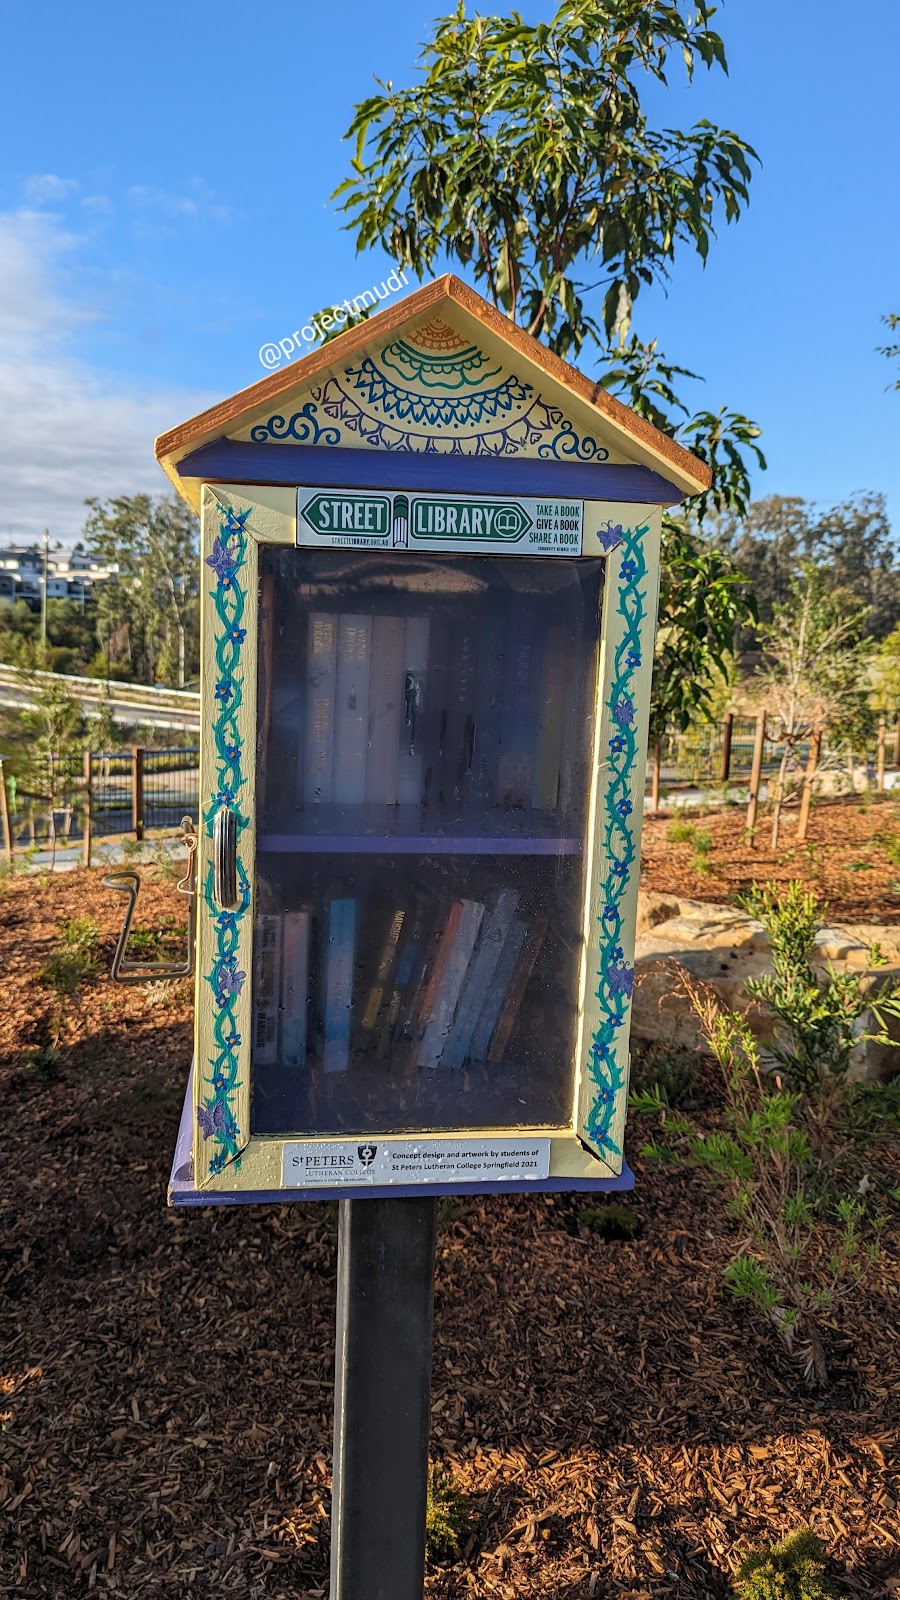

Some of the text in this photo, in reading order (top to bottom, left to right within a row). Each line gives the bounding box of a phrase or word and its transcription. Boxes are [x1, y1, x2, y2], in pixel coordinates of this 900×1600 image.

[318, 500, 495, 535] STREET LIBRARY
[536, 504, 580, 518] TAKE A BOOK
[536, 518, 579, 531] GIVE A BOOK
[331, 537, 388, 546] STREETLIBRARY.ORG.AU
[528, 532, 579, 545] SHARE A BOOK
[305, 1155, 354, 1166] PETERS
